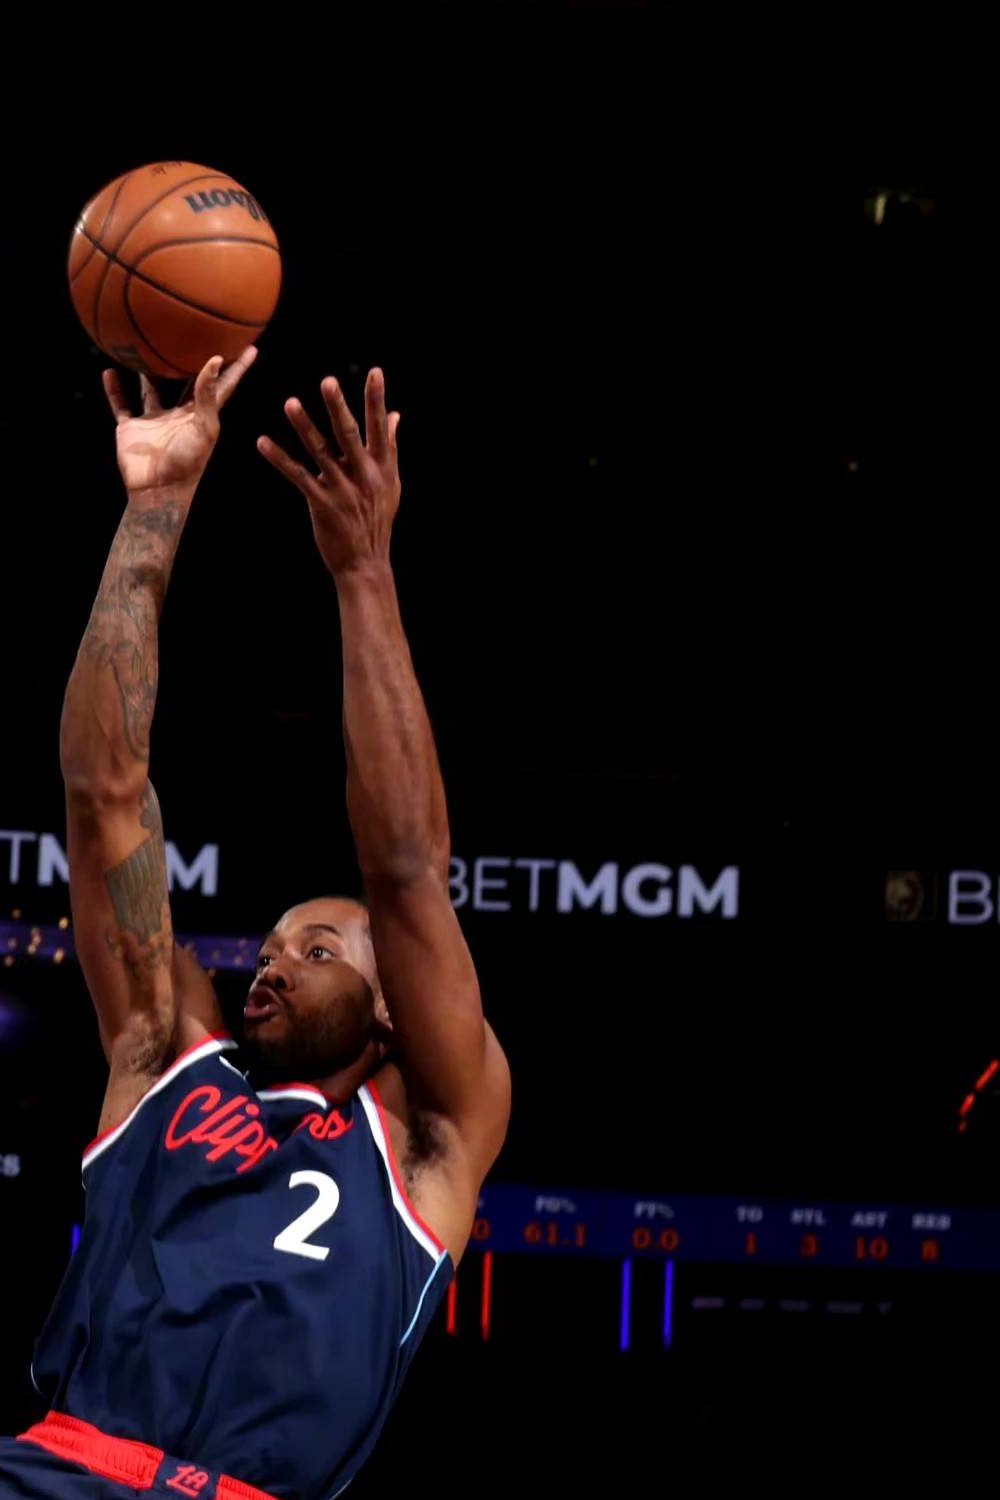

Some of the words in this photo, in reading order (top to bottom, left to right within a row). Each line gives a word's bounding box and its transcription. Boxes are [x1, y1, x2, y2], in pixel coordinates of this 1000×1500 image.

[184, 188, 268, 221] lson
[165, 1085, 354, 1174] Clipprs
[273, 1169, 341, 1261] 2
